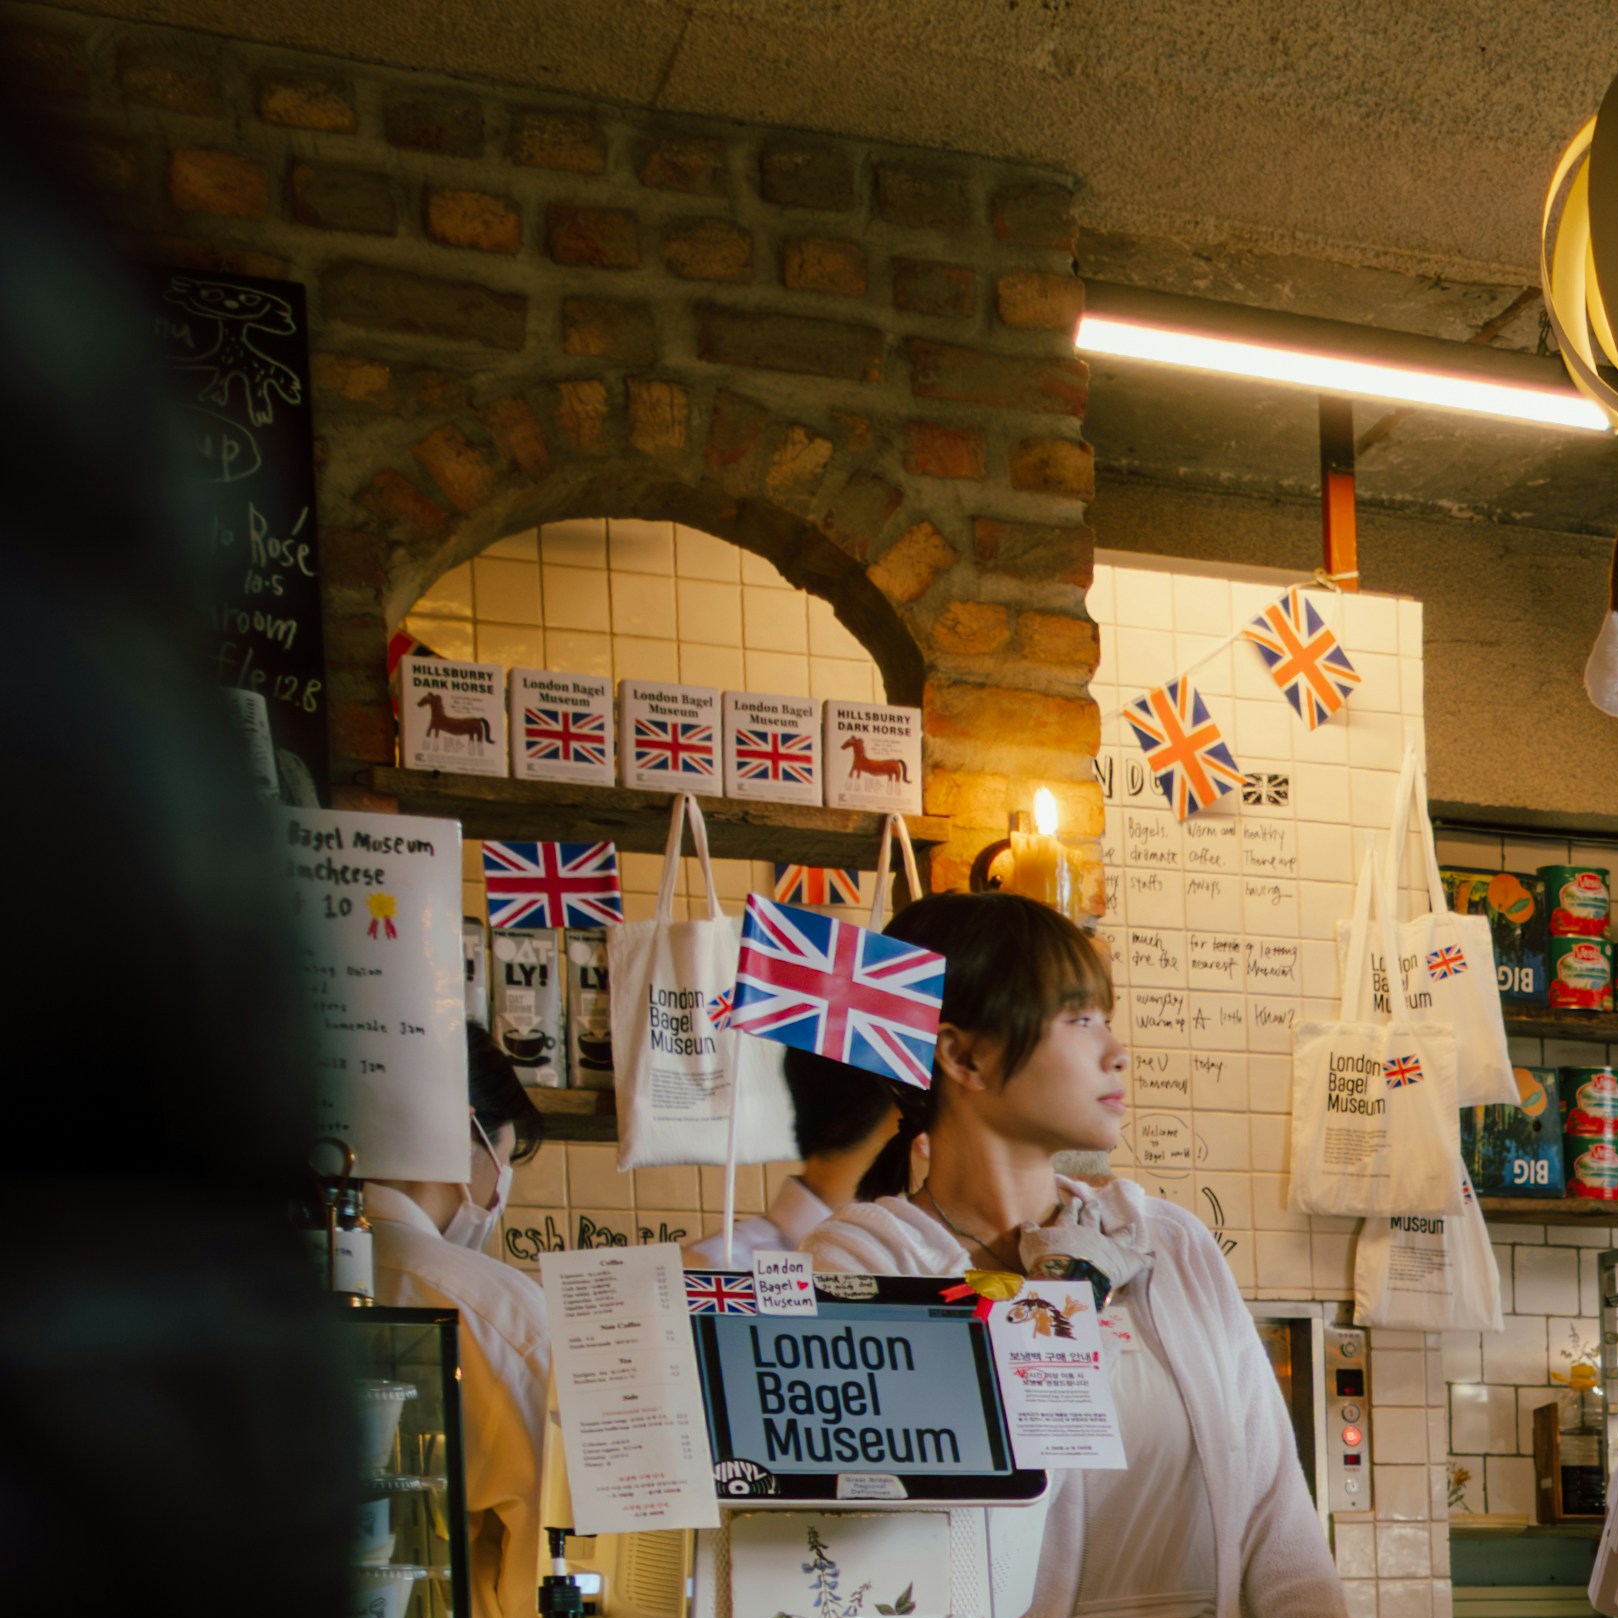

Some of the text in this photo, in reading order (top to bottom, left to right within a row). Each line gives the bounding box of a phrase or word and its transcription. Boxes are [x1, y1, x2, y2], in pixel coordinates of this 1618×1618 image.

[412, 664, 494, 681] HILLSBURRY
[413, 677, 494, 695] DARK HORSE
[523, 678, 605, 697] London Bagel
[539, 692, 590, 708] Museum
[633, 689, 713, 708] London Bagel
[649, 703, 699, 718] Museum
[734, 700, 813, 718] London Bagel
[837, 709, 912, 725] HILLSBURRY
[749, 714, 798, 728] Museum
[838, 721, 911, 737] DARK HORSE
[505, 963, 548, 988] LY!
[1498, 966, 1534, 993] BIG
[649, 984, 704, 1010] London
[650, 1007, 692, 1037] Bagel
[1329, 1052, 1381, 1078] London
[1328, 1074, 1368, 1097] Bagel
[1327, 1091, 1386, 1116] Museum
[1513, 1159, 1549, 1184] BIG
[757, 1258, 804, 1275] London
[760, 1280, 793, 1295] Bagel
[763, 1296, 813, 1309] Museum
[749, 1325, 915, 1371] London
[756, 1371, 881, 1425] Bagel
[762, 1417, 961, 1463] Museum
